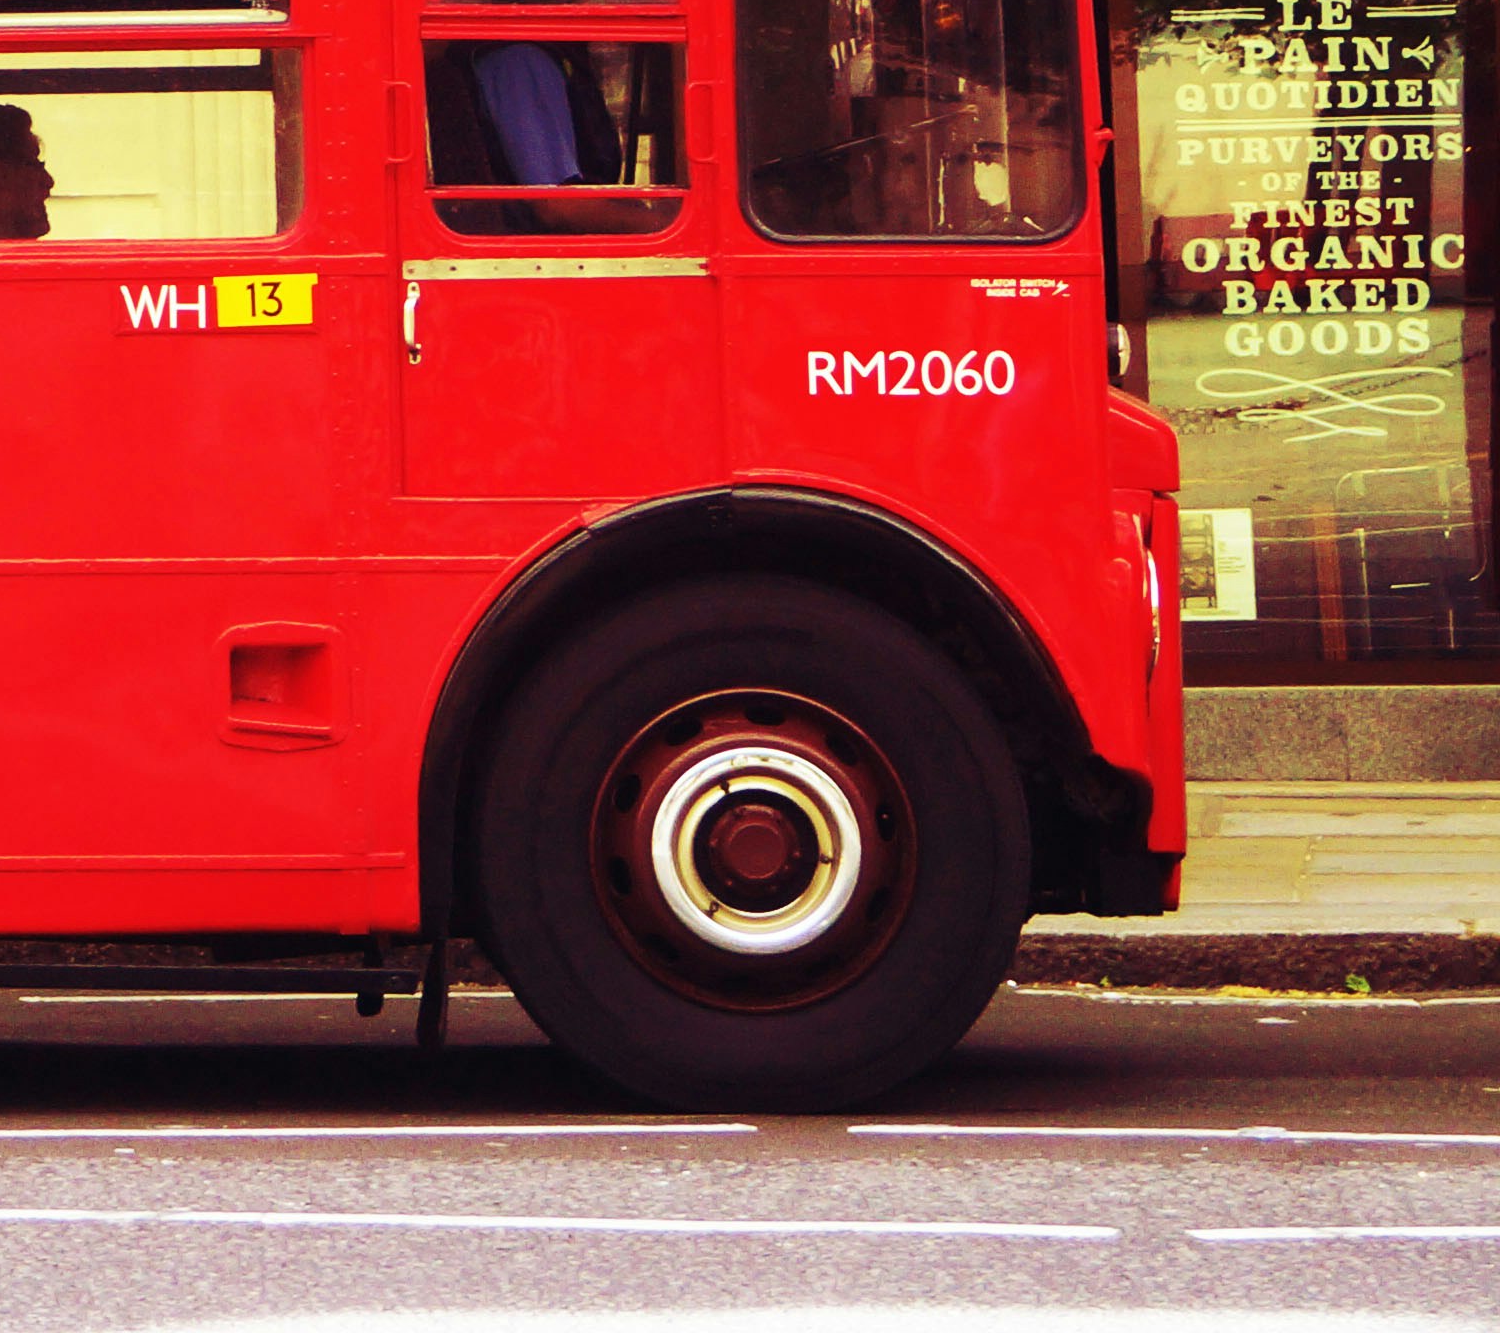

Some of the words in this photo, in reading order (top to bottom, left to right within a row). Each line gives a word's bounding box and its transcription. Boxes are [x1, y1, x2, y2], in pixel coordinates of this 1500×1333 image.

[1239, 36, 1392, 75] PAIN
[1174, 78, 1460, 114] QUOTIDIEN
[1177, 133, 1463, 166] PURVEYORS
[1261, 172, 1302, 192] OF
[1316, 171, 1380, 190] THE
[1229, 197, 1414, 229] FINEST
[1181, 233, 1464, 273] ORGANIC
[120, 284, 207, 329] WH
[246, 281, 284, 318] 13
[1222, 278, 1431, 315] BAKED
[1224, 318, 1431, 357] GOODS
[807, 350, 1016, 396] RM2060
